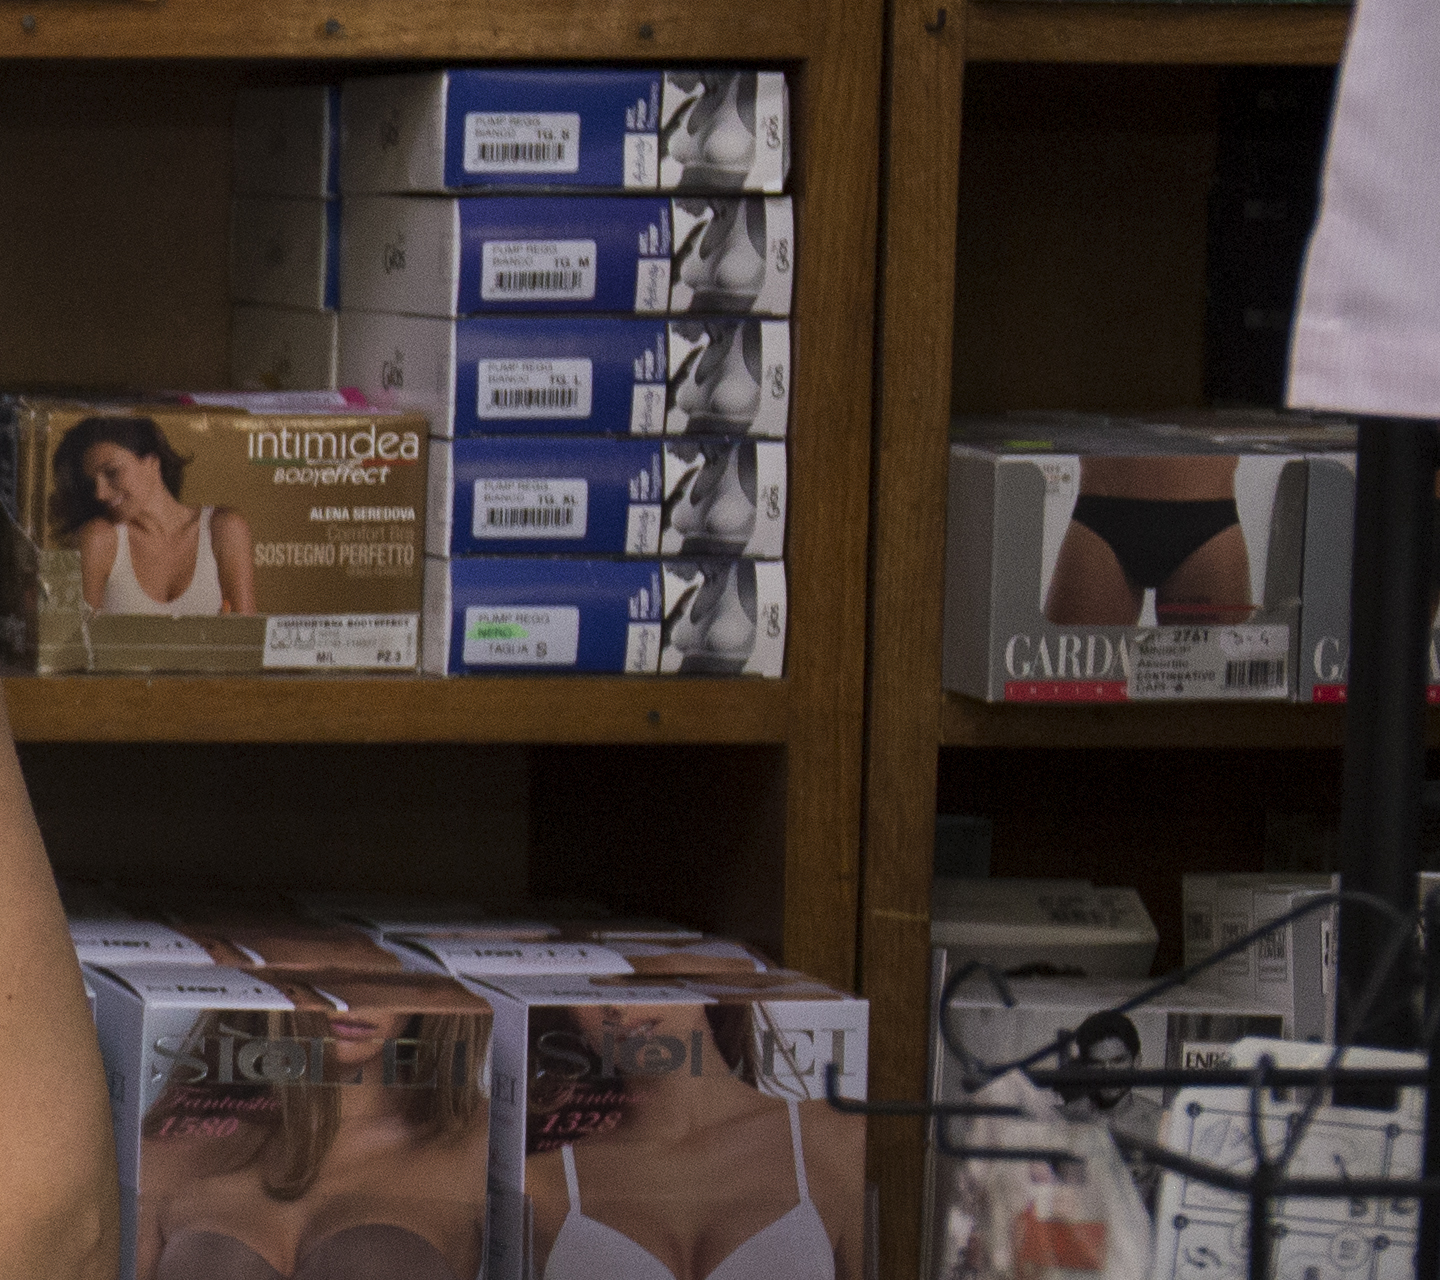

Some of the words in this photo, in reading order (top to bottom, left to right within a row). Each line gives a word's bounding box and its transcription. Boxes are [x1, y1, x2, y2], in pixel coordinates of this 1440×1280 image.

[249, 424, 419, 460] intimidea
[353, 507, 416, 521] SEREDOVA
[254, 543, 335, 566] SOSTEGNO
[339, 543, 415, 566] PERFETTO
[1006, 632, 1132, 678] GARDA
